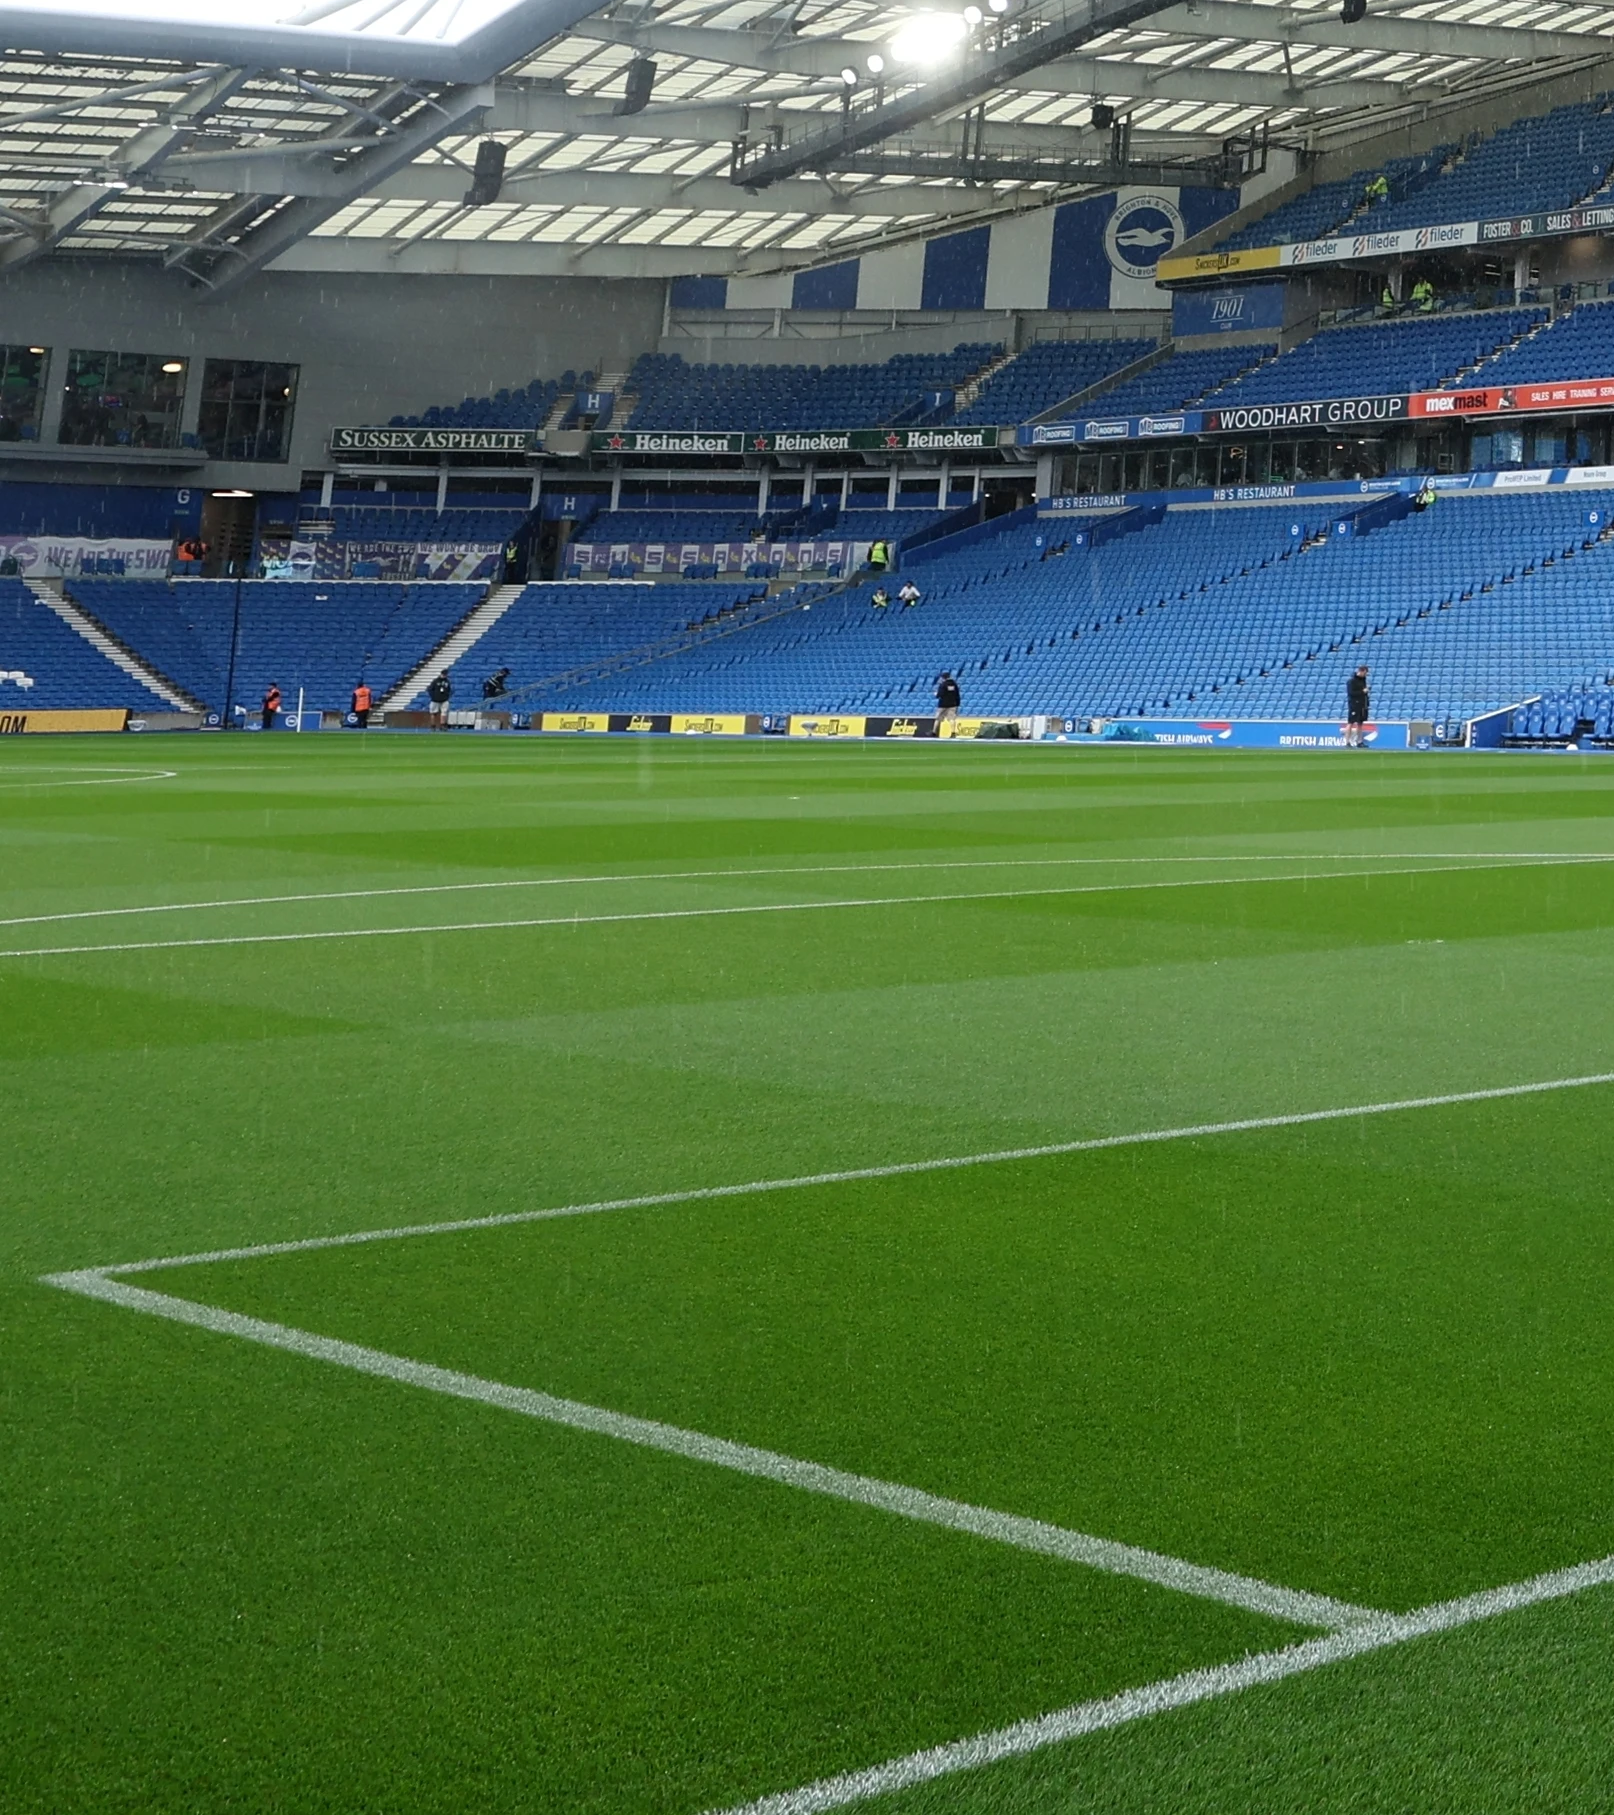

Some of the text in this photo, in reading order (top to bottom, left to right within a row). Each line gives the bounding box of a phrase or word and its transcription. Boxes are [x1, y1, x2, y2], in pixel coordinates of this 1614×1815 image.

[1114, 198, 1152, 221] BRIGHTON
[1160, 204, 1179, 221] HOVE
[1483, 221, 1511, 238] FOSTER
[1520, 219, 1533, 234] CO.
[1546, 214, 1571, 231] SALES
[1430, 225, 1465, 242] fileder
[1305, 241, 1338, 258] fileder
[1366, 234, 1400, 251] fileder
[1211, 298, 1244, 319] 1901
[588, 394, 600, 408] H
[1426, 392, 1488, 412] mexmast
[1531, 391, 1550, 402] SALES
[1552, 390, 1567, 401] HIRE
[1570, 387, 1597, 399] TRAINING
[1220, 398, 1402, 430] WOODHART GROUP
[339, 429, 525, 449] SUSSEX ASPHALTE
[634, 434, 730, 451] Heineken
[773, 433, 850, 451] Heineken
[906, 431, 983, 449] Heineken
[177, 489, 191, 504] G
[1214, 485, 1296, 501] HB'S RESTAURANT
[563, 497, 575, 510] H
[1052, 495, 1126, 509] HB'S RESTAURANT
[1280, 736, 1317, 746] BRITISH
